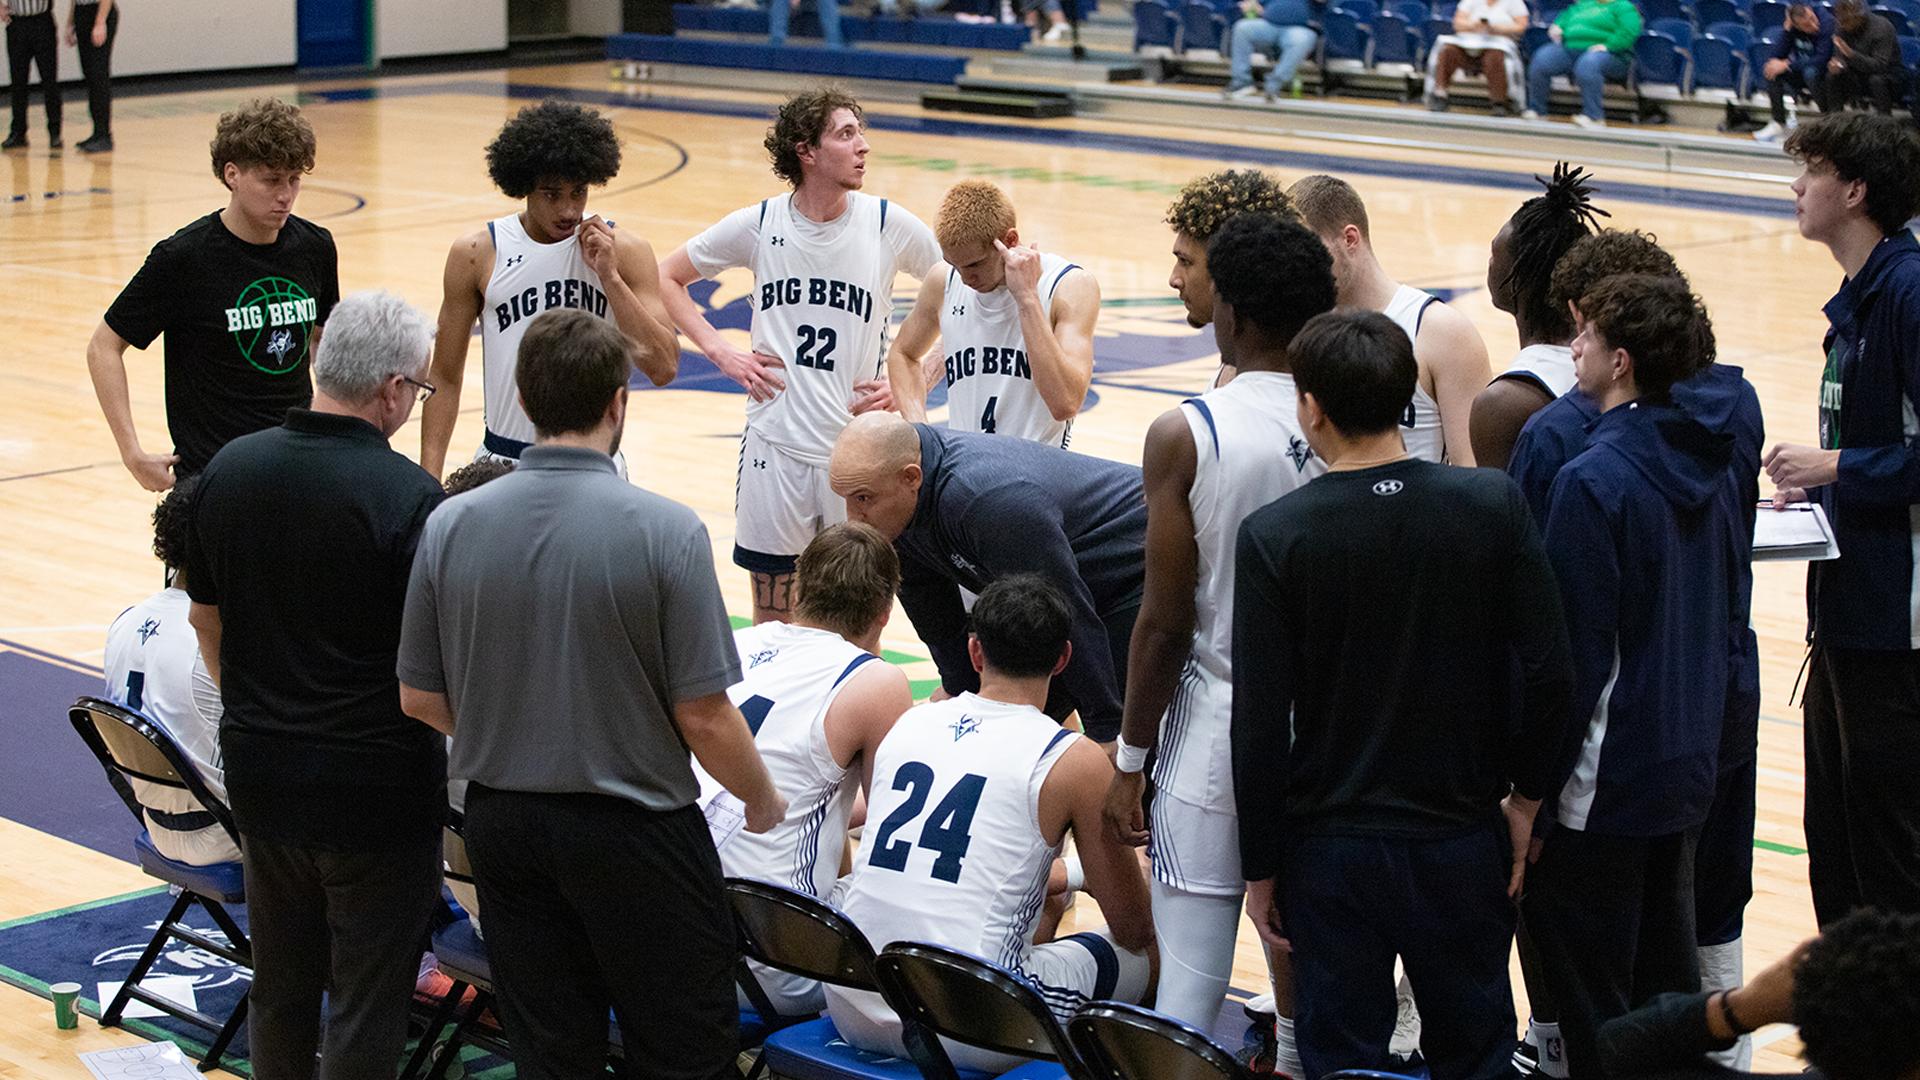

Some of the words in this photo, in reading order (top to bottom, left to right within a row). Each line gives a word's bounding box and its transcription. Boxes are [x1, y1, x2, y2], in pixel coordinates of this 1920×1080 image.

[225, 305, 264, 332] BIG
[268, 297, 317, 327] BEND
[495, 287, 539, 333] BIG
[544, 279, 608, 319] BEND
[761, 278, 802, 311] BIG
[795, 324, 837, 372] 22
[945, 347, 976, 389] BIG
[981, 346, 1032, 380] BEN
[981, 396, 998, 434] 4
[868, 761, 988, 884] 24
